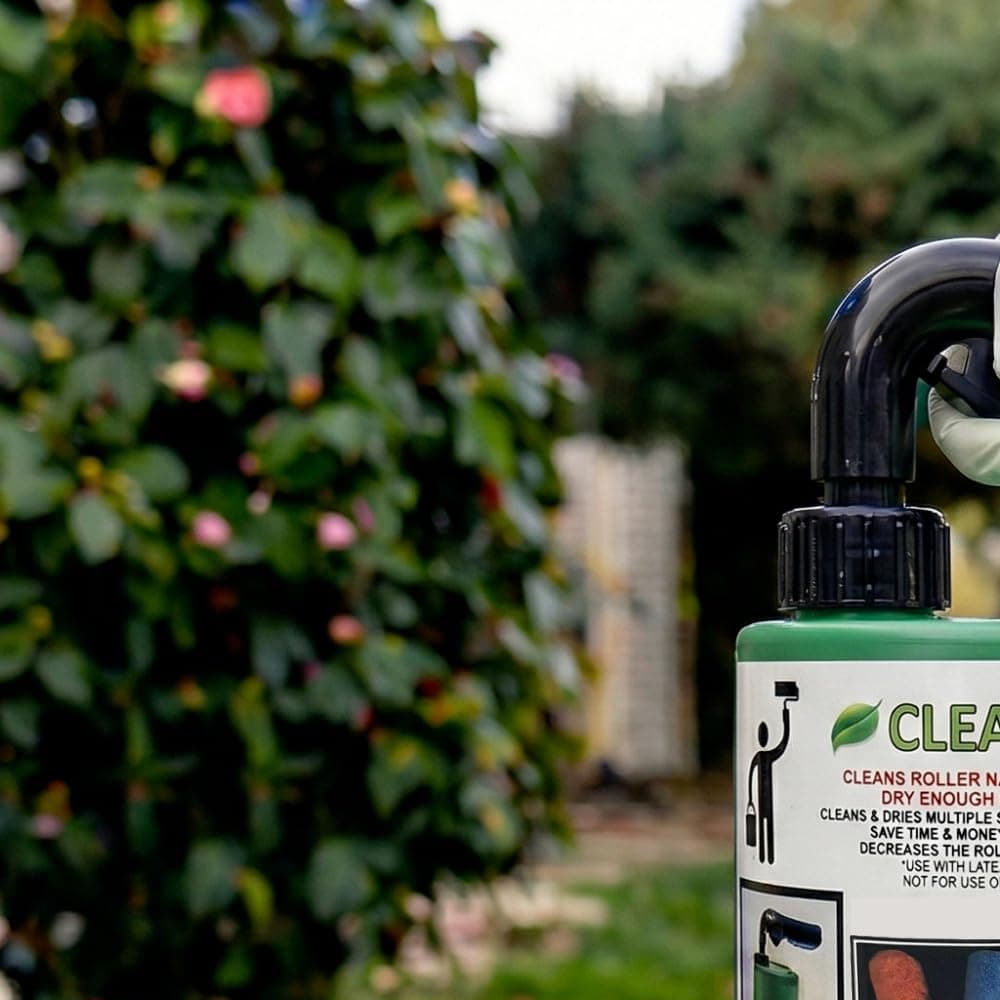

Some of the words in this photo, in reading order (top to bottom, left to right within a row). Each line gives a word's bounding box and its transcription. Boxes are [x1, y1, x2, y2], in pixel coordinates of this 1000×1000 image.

[843, 770, 905, 785] CLEANS
[911, 772, 980, 786] ROLLER
[881, 791, 915, 805] DRY
[919, 791, 994, 806] ENOUGH
[820, 808, 866, 821] CLEANS
[871, 810, 879, 822] &
[883, 810, 922, 823] DRIES
[926, 811, 992, 824] MULTIPLE
[870, 826, 903, 839] SAVE
[907, 827, 938, 840] TIME
[943, 828, 951, 840] &
[860, 842, 939, 856] DECREASES
[943, 845, 969, 857] THE
[934, 861, 964, 872] WITH
[903, 875, 928, 887] NOT
[932, 876, 956, 888] FOR
[961, 876, 986, 888] USE
